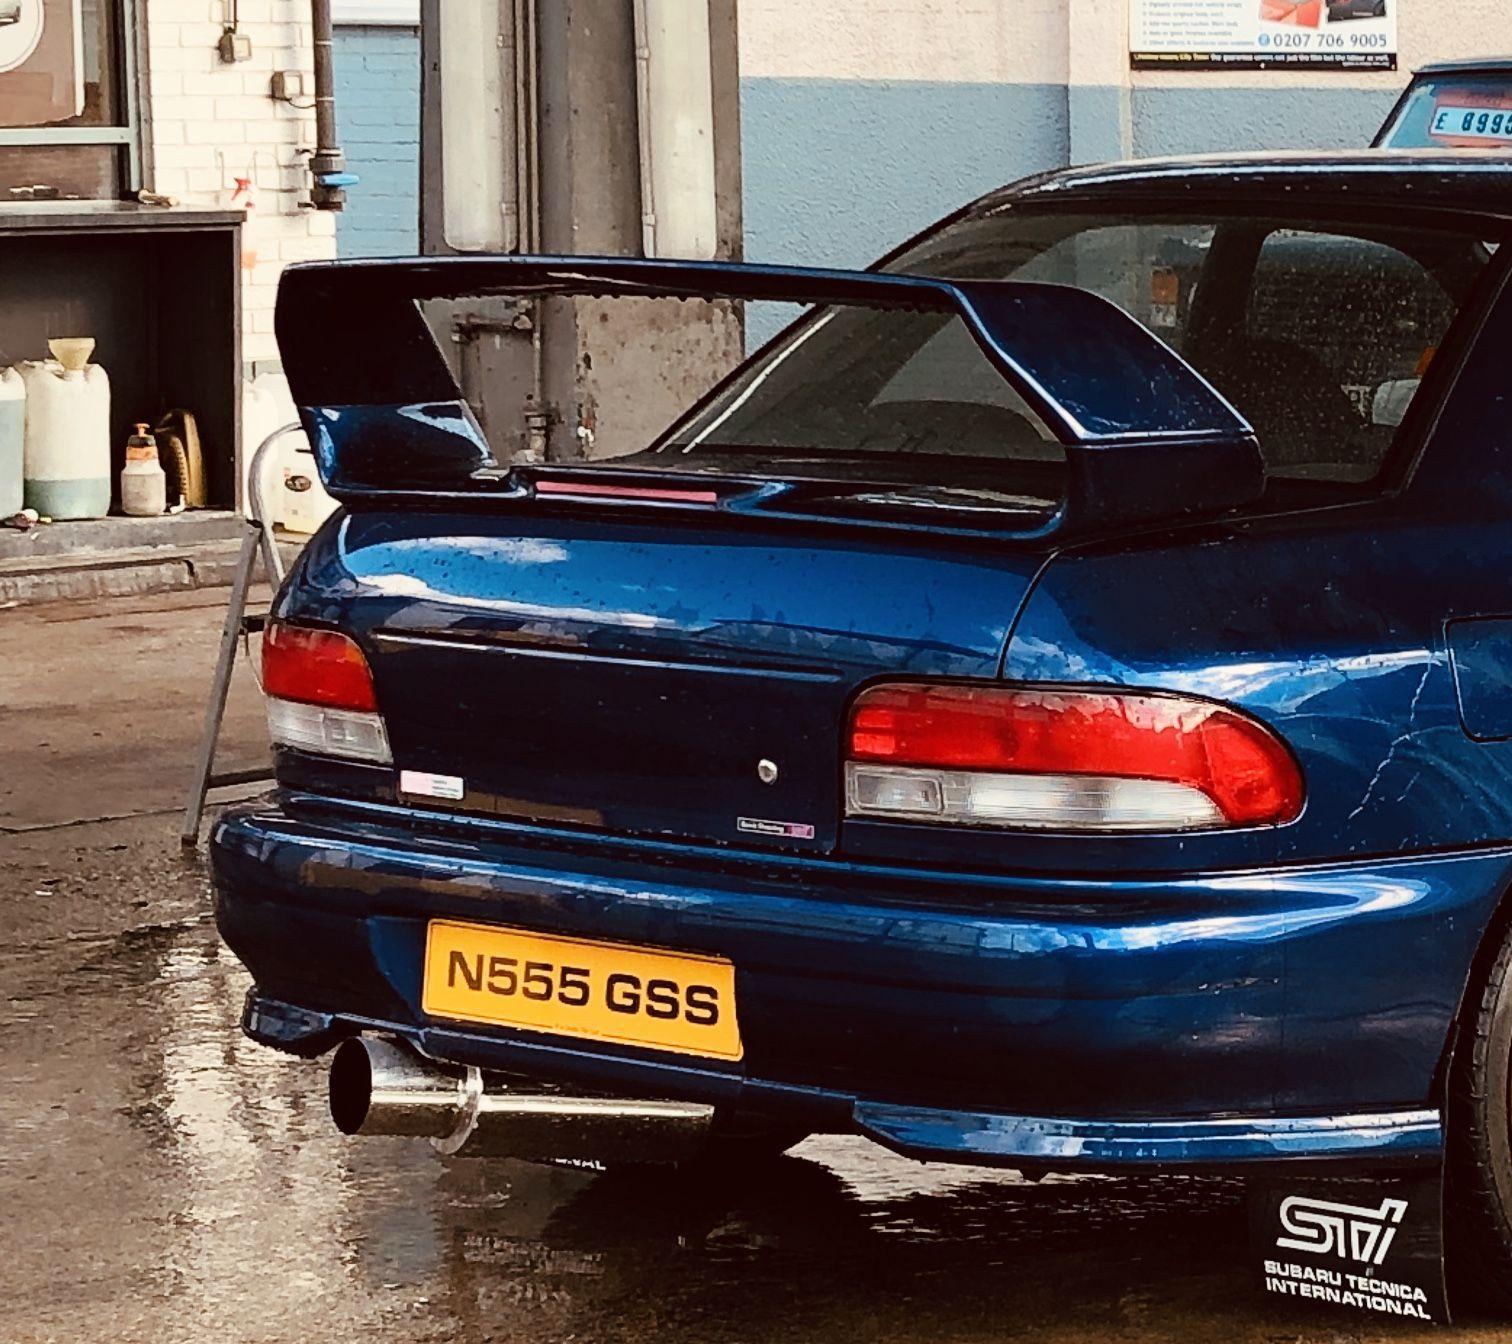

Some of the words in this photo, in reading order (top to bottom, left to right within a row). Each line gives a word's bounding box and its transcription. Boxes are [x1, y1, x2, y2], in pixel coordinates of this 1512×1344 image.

[1274, 34, 1311, 47] 0207
[1317, 34, 1344, 47] 706
[1350, 34, 1387, 47] 9005
[448, 950, 591, 1007] N555
[605, 973, 720, 1027] GSS
[1264, 1260, 1342, 1287] SUBARU
[1345, 1274, 1428, 1304] TECNICA
[1265, 1277, 1432, 1320] INTERNATIONAL
